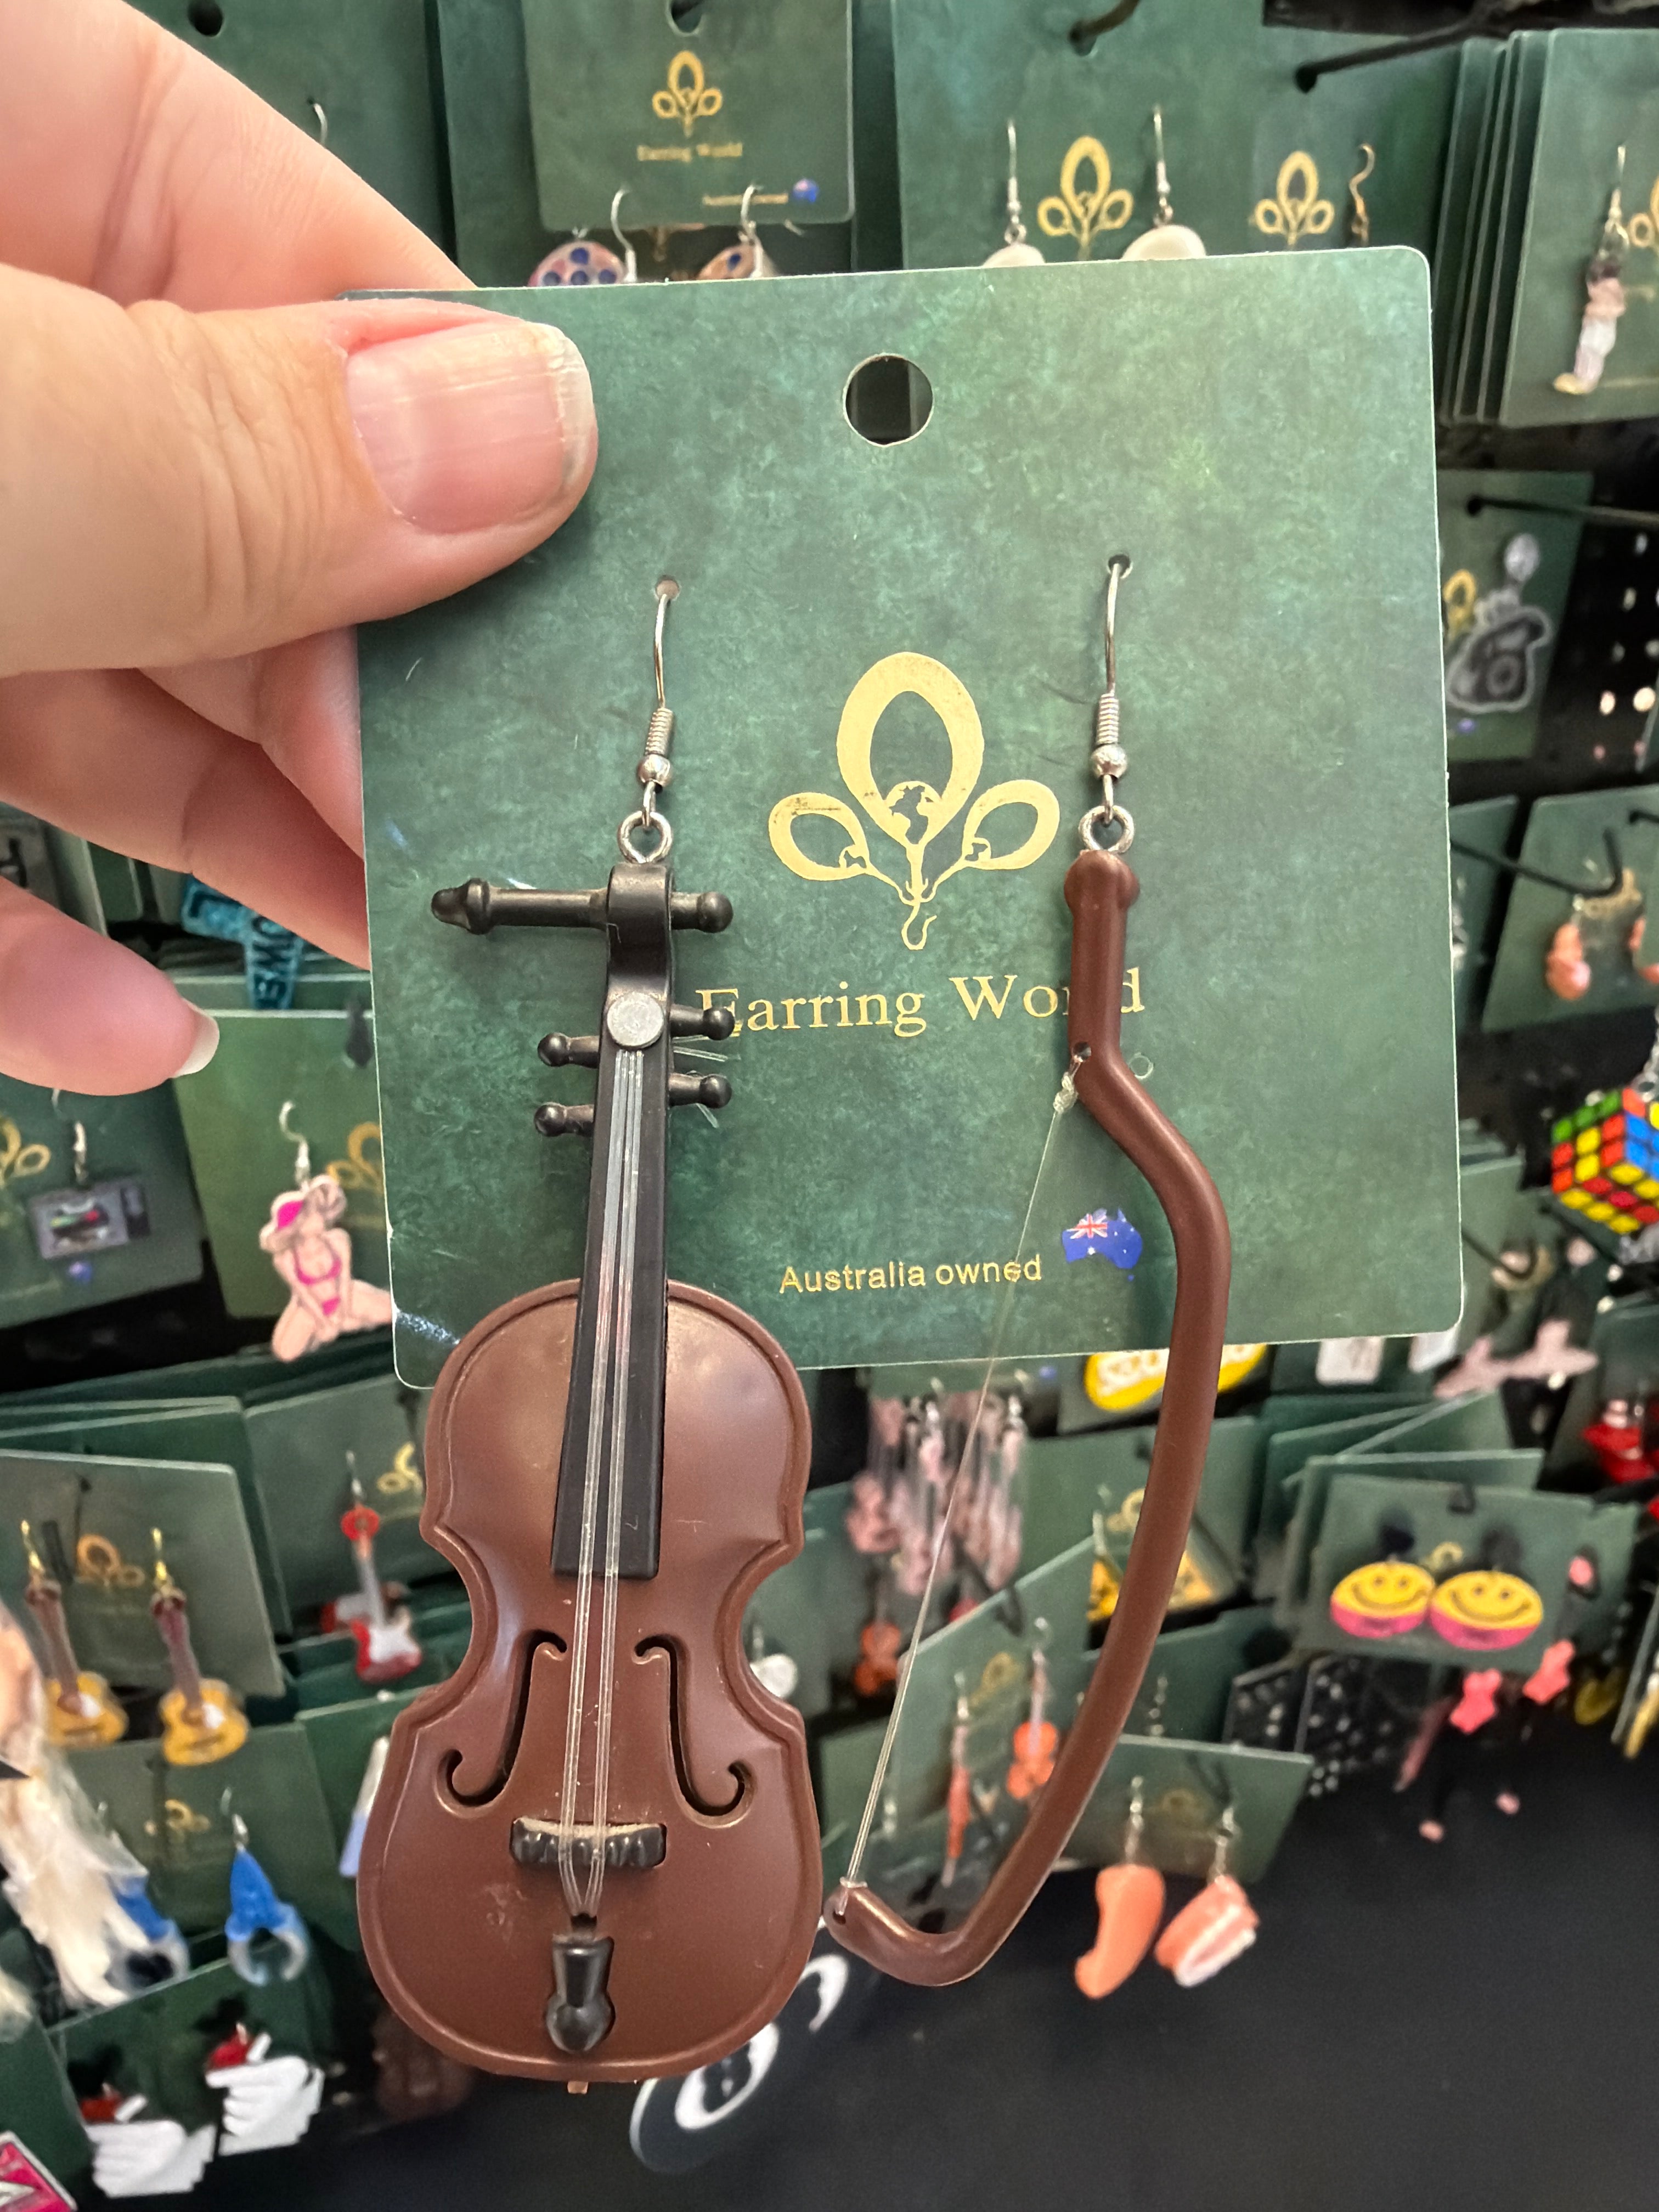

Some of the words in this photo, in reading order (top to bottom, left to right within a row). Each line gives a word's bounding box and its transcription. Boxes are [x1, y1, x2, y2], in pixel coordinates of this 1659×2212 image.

[949, 966, 1146, 1021] Wod
[779, 1261, 926, 1294] Australia
[935, 1254, 1042, 1285] owned
